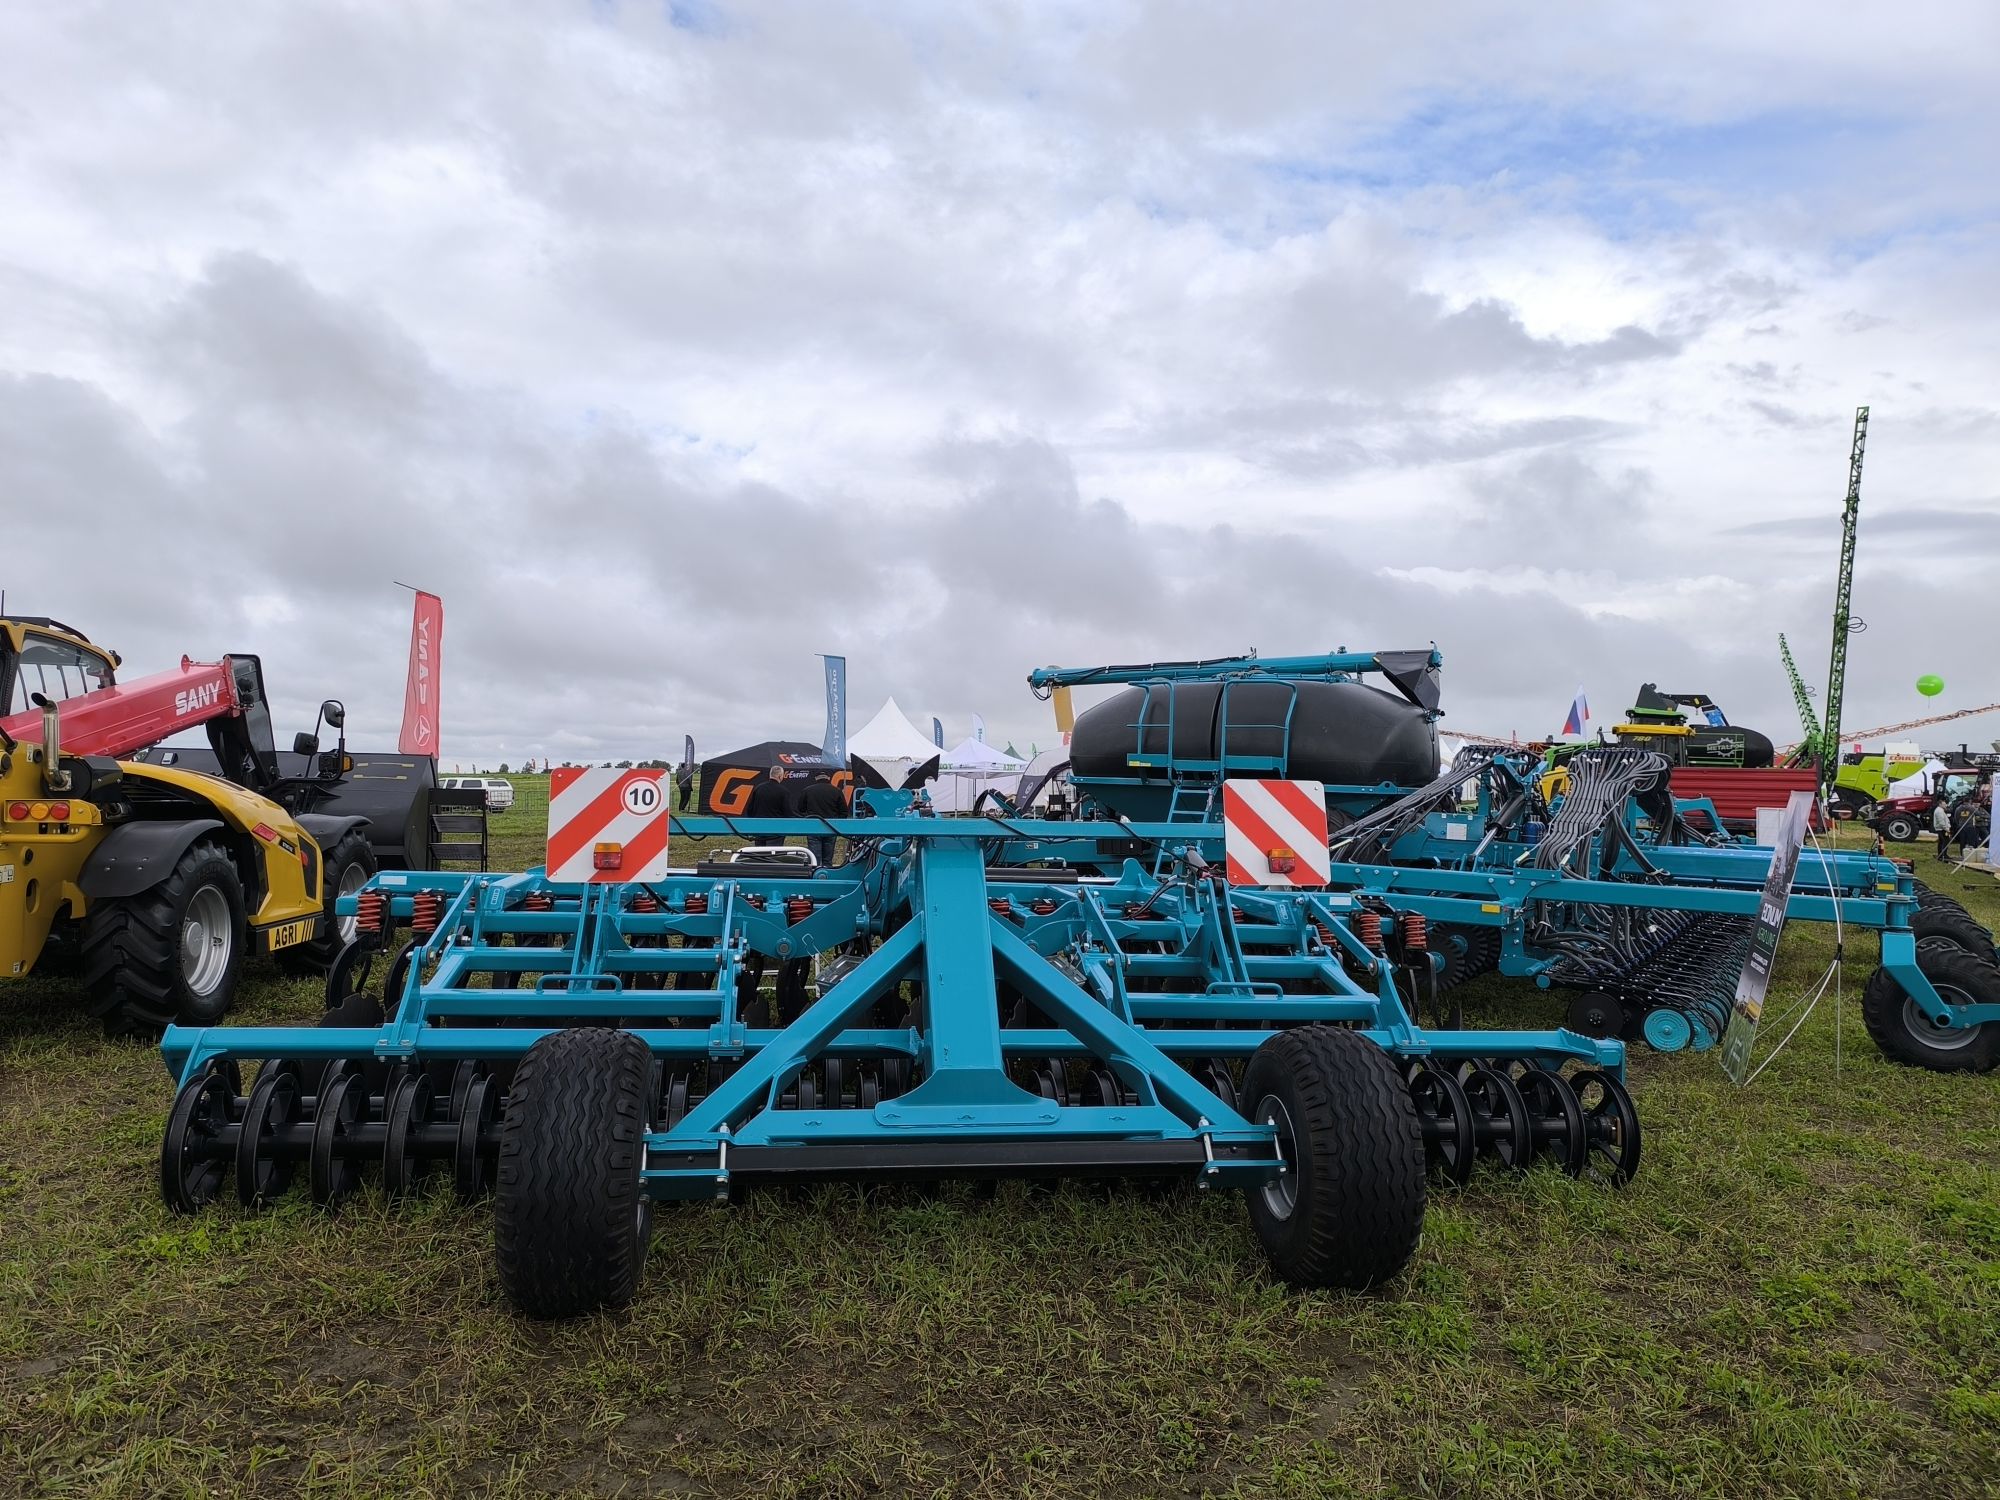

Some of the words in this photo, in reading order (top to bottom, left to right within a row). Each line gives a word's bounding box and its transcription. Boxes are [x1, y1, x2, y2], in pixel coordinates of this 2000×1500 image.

[175, 680, 220, 717] SANY
[629, 788, 655, 806] 10
[709, 768, 761, 816] G
[1761, 903, 1782, 928] BONUM
[274, 923, 298, 948] AGRI
